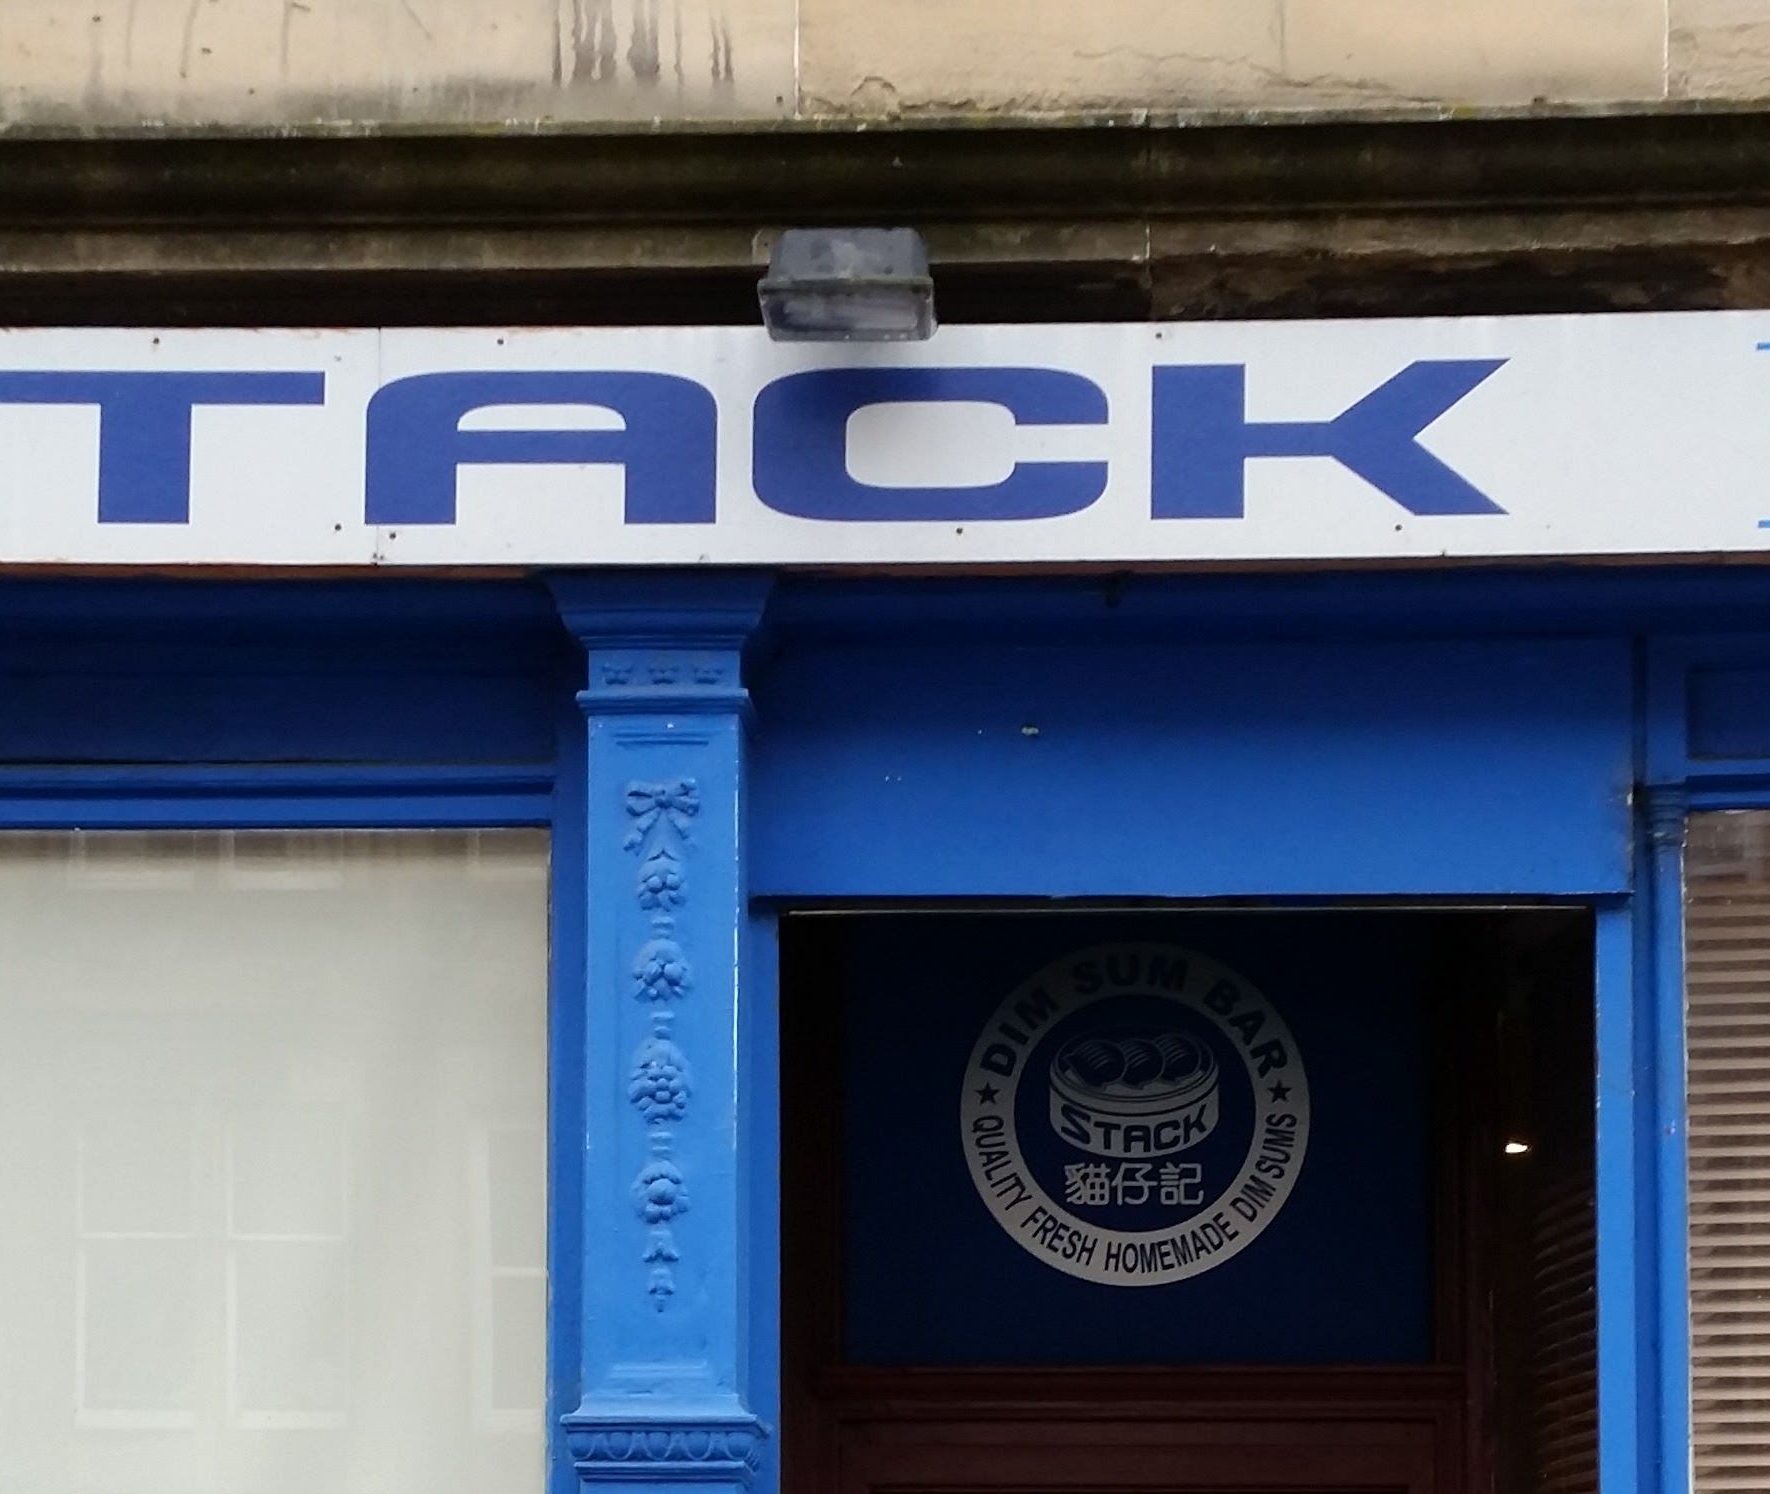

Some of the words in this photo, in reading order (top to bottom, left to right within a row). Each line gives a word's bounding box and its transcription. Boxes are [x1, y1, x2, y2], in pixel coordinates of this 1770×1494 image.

[980, 988, 1061, 1078] DIM
[1072, 953, 1189, 995] SUM
[1203, 977, 1289, 1078] BAR
[1061, 1103, 1207, 1153] STACK
[972, 1114, 1032, 1212] QUALITY
[1021, 1205, 1097, 1267] FRESH
[1104, 1212, 1240, 1274] HOMEMADE
[1229, 1178, 1277, 1224] DIM
[1255, 1112, 1298, 1180] SUMS
[1064, 1162, 1205, 1206] 貓仔記
